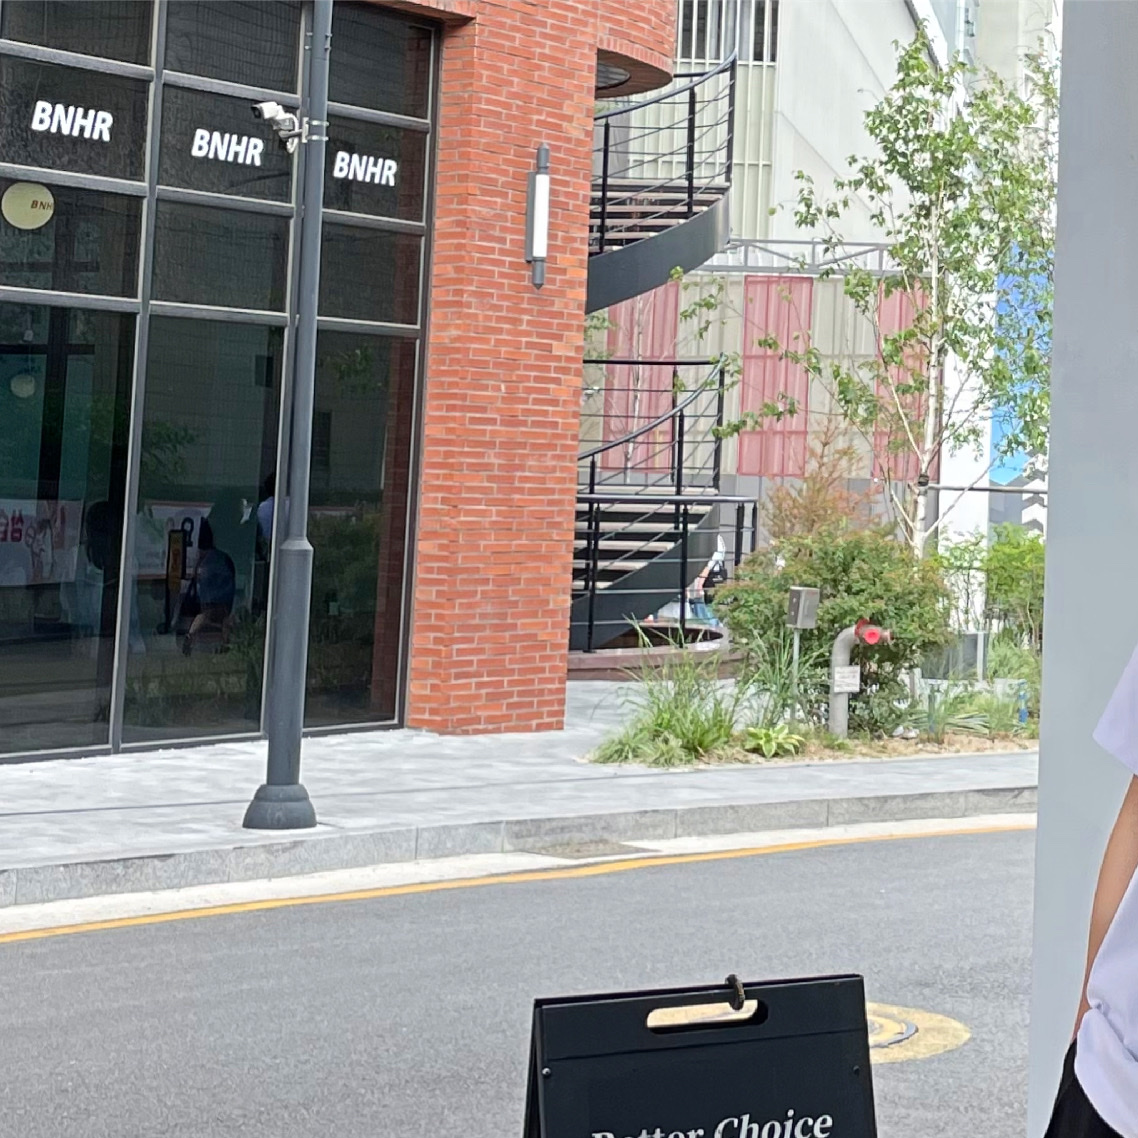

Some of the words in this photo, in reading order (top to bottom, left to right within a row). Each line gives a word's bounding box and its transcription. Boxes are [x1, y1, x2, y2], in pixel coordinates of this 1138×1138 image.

[31, 100, 113, 142] BNHR
[191, 128, 264, 166] BNHR
[333, 151, 398, 186] BNHR
